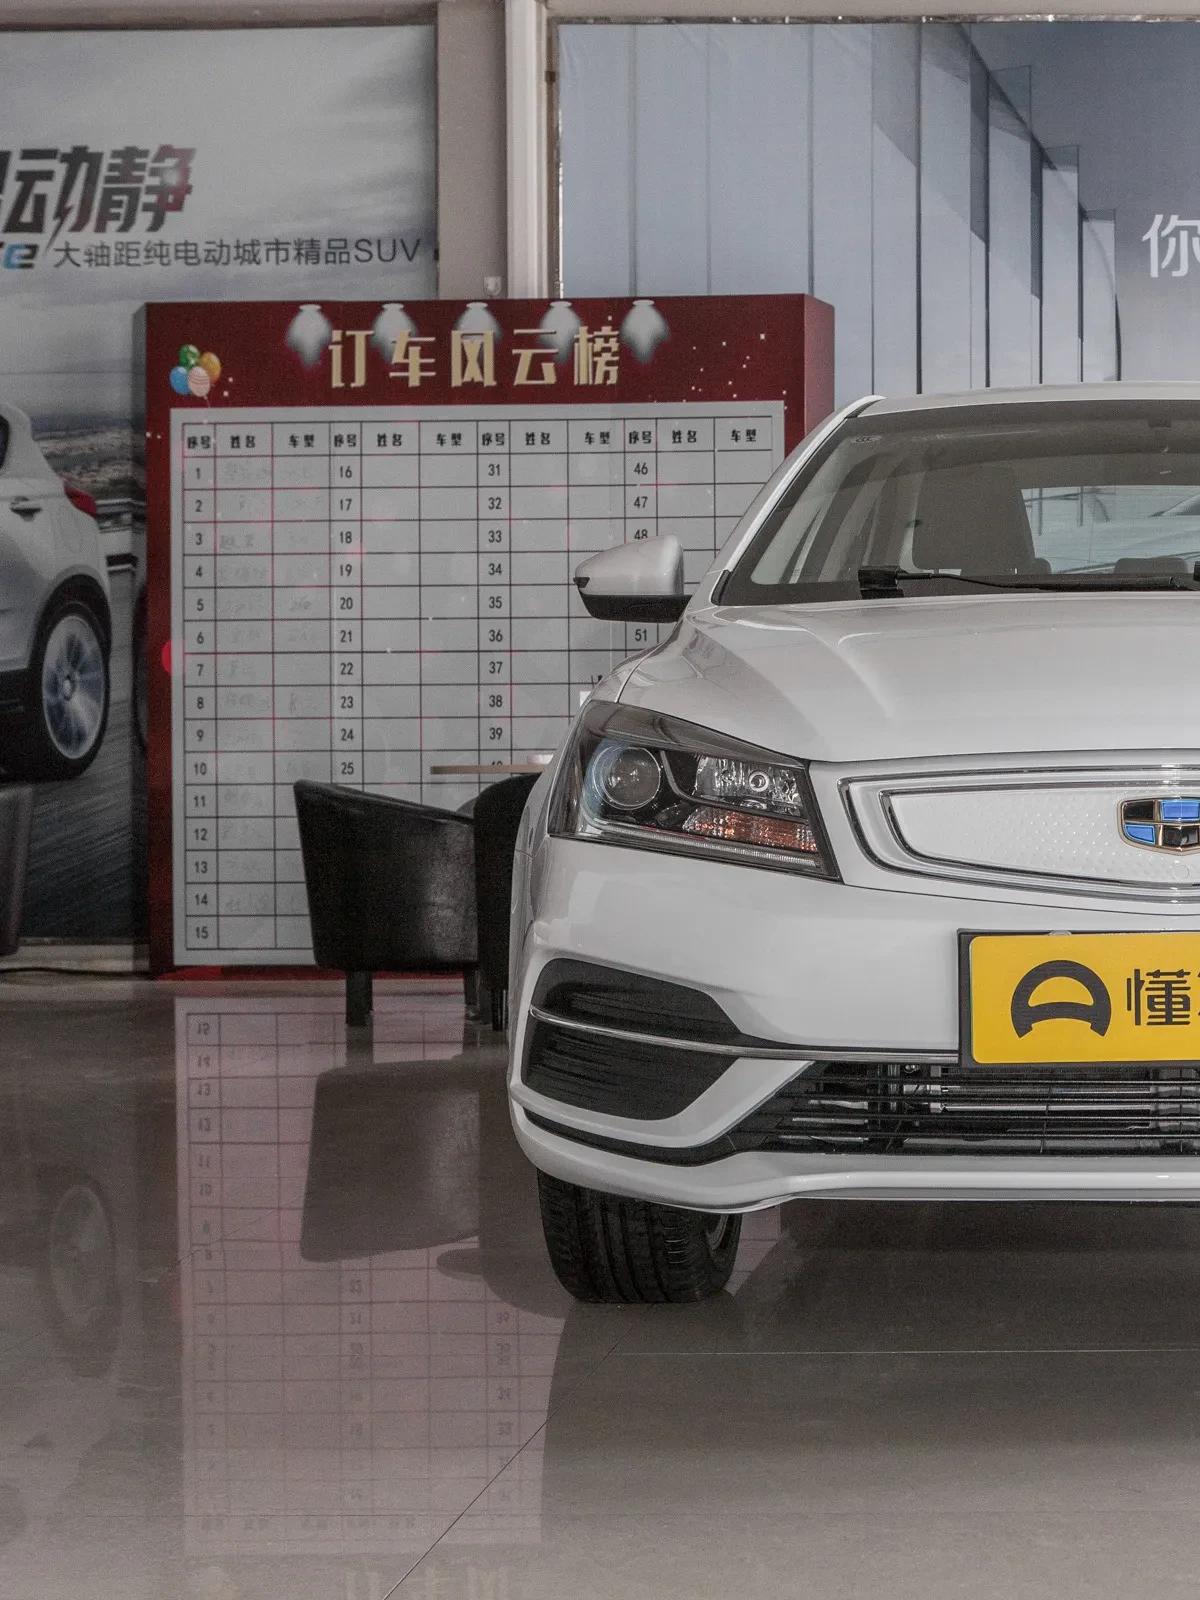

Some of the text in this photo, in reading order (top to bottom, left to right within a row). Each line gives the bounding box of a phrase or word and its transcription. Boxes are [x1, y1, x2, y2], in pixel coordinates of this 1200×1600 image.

[0, 144, 196, 240] 云动静
[53, 237, 422, 268] 大轴距纯电动城市精品SUV
[328, 326, 620, 388] 订车风云榜
[187, 435, 211, 449] 序号
[230, 434, 256, 449] 姓名
[289, 434, 315, 449] 车型
[333, 433, 357, 448] 序号
[376, 433, 403, 448] 姓名
[436, 432, 462, 447] 车型
[481, 432, 505, 447] 序号
[525, 431, 551, 446] 姓名
[584, 431, 610, 445] 车型
[628, 430, 652, 445] 序号
[671, 429, 697, 444] 姓名
[731, 428, 757, 443] 车型
[339, 465, 353, 479] 16
[487, 463, 502, 477] 31
[633, 462, 649, 476] 46
[339, 497, 353, 512] 17
[487, 496, 502, 511] 32
[633, 495, 649, 509] 47
[339, 530, 353, 544] 18
[487, 529, 503, 544] 33
[339, 563, 353, 577] 19
[488, 562, 503, 576] 34
[339, 596, 354, 610] 20
[488, 595, 503, 609] 35
[339, 629, 353, 643] 21
[488, 629, 503, 643] 36
[633, 627, 649, 643] 51
[339, 661, 354, 676] 22
[488, 660, 504, 675] 37
[339, 695, 354, 710] 23
[488, 694, 503, 708] 38
[340, 727, 355, 742] 24
[488, 726, 504, 741] 39
[193, 761, 208, 776] 10
[340, 761, 355, 776] 25
[193, 795, 207, 808] 11
[193, 827, 208, 842] 12
[194, 860, 209, 874] 13
[194, 893, 209, 906] 14
[194, 925, 209, 940] 15
